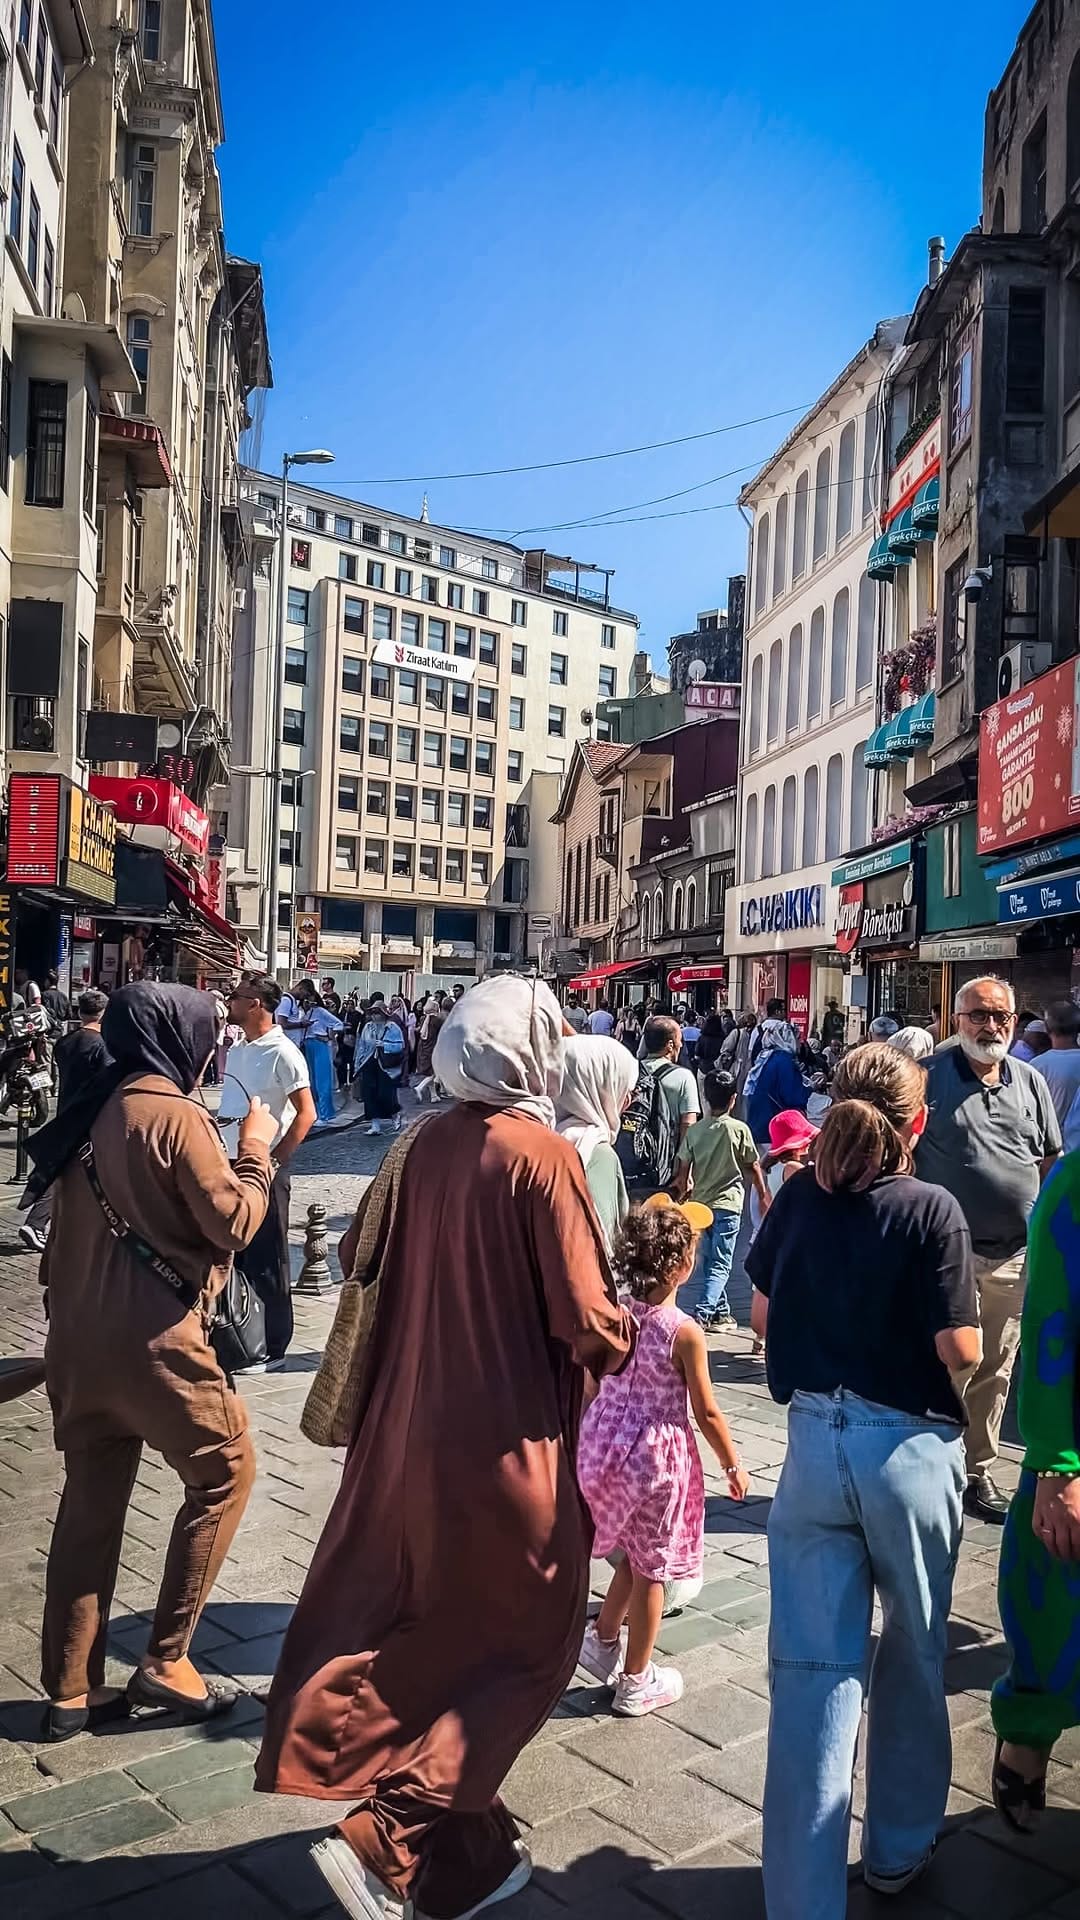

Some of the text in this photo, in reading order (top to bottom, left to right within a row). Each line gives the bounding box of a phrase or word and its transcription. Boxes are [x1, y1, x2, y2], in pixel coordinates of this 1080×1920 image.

[406, 651, 430, 667] Ziraat
[691, 688, 732, 705] ACA
[1002, 773, 1033, 823] 800
[83, 797, 117, 845] CHANGE
[81, 835, 115, 877] EXCHANGE
[861, 900, 904, 941] Börekçisi
[790, 994, 808, 1012] İNDİRİM
